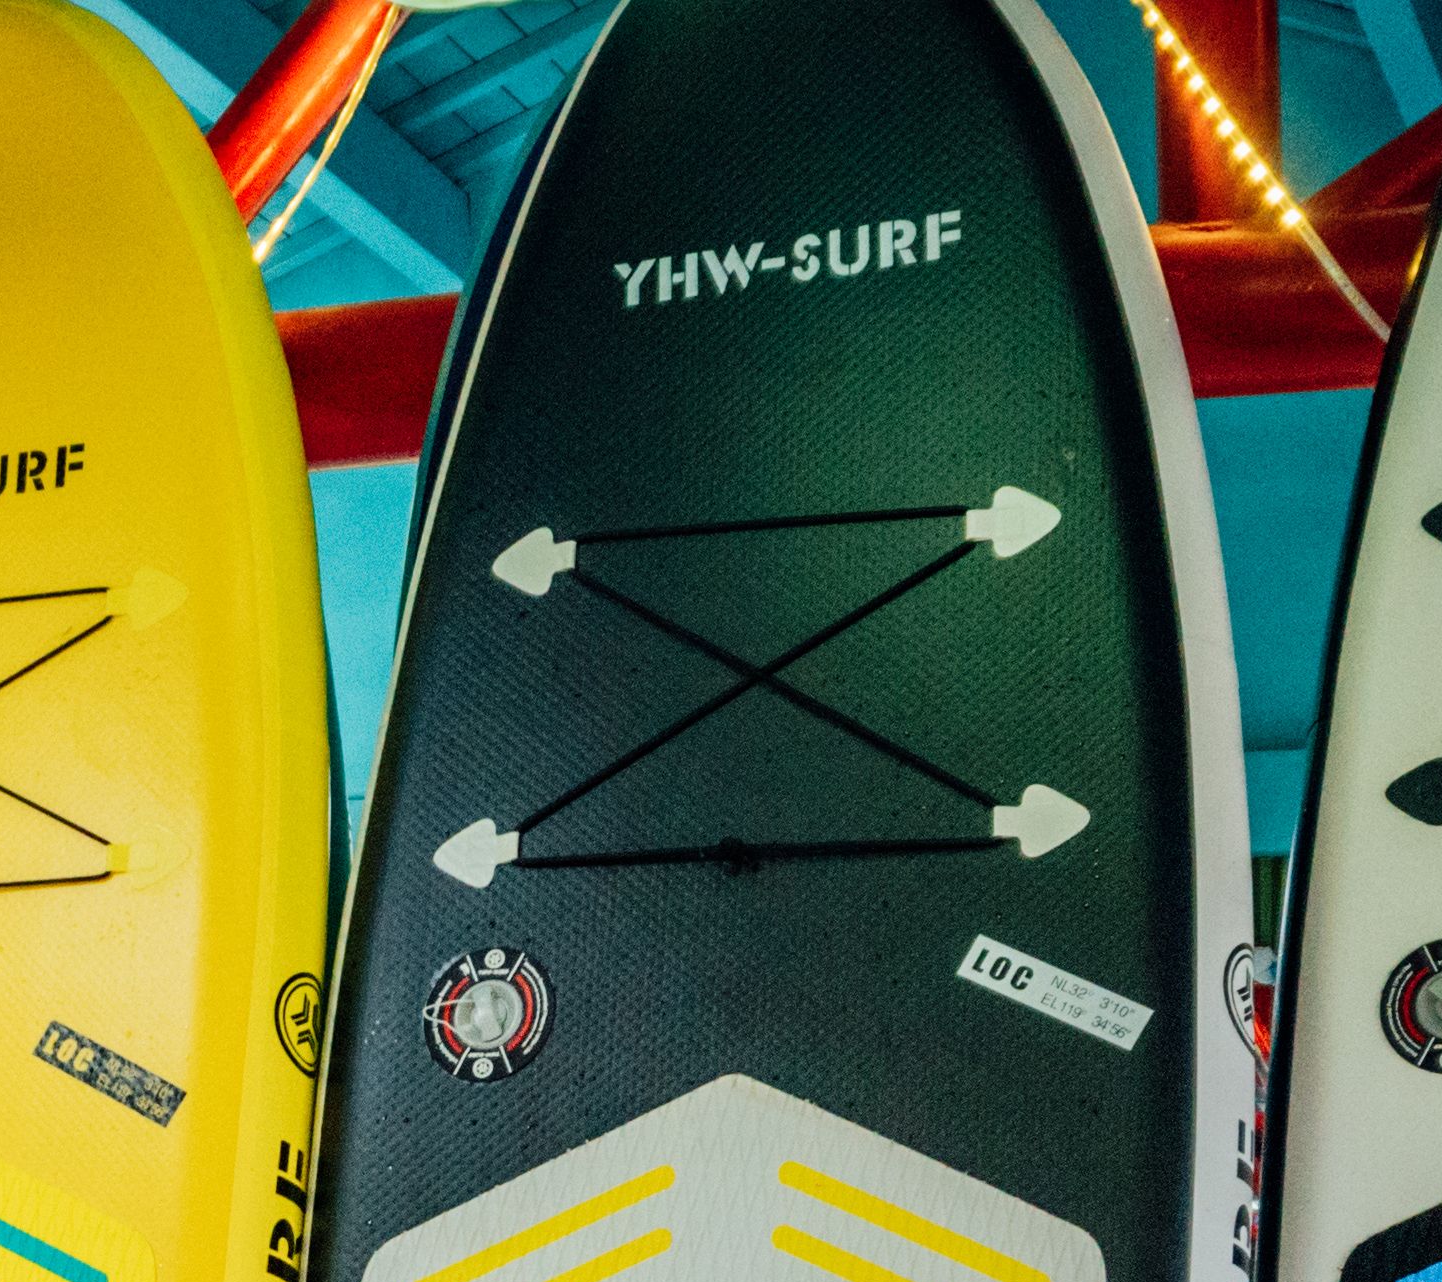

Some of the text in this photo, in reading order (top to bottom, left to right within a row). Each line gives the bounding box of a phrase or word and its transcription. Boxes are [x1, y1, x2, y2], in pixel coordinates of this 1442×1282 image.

[614, 209, 962, 309] YHW-SURF
[972, 948, 1034, 990] LOC
[42, 1029, 95, 1072] LOC
